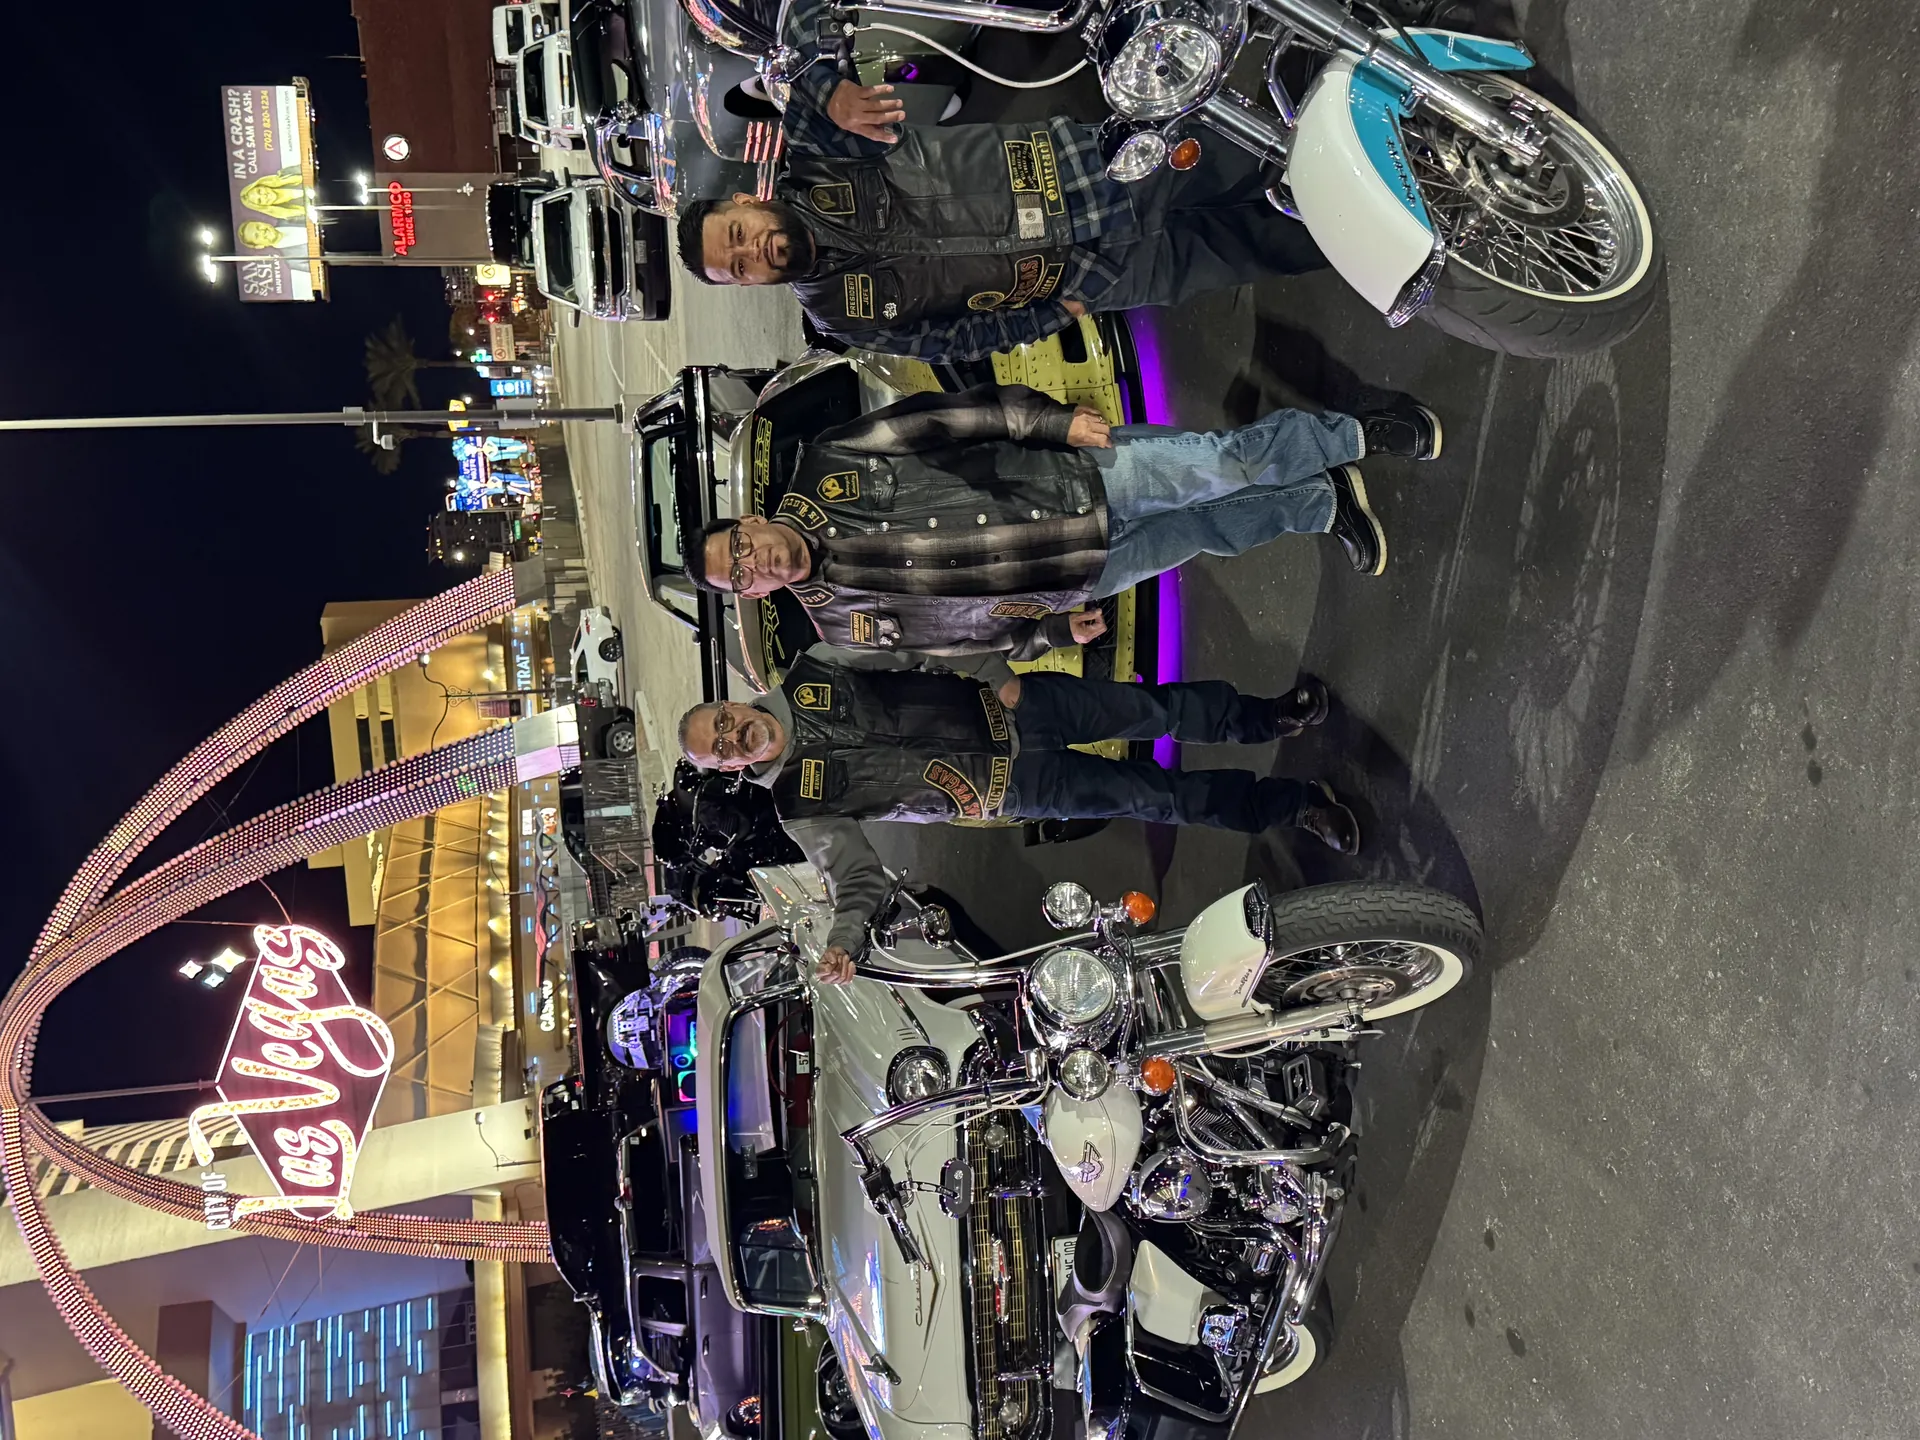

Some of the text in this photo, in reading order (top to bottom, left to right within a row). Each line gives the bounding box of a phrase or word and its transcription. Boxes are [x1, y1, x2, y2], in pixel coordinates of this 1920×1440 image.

[242, 90, 253, 114] ASH.
[227, 89, 247, 179] IN A CRASH?
[245, 126, 256, 148] SAM
[264, 130, 274, 151] (702)
[248, 150, 258, 174] CALL
[1035, 141, 1059, 201] Outreach
[388, 181, 407, 255] ALARMCO
[406, 217, 416, 246] SINCE
[847, 276, 857, 315] PRESIDENT
[981, 690, 1006, 738] OUTREACH
[928, 765, 975, 804] VEGAS
[987, 760, 1006, 808] VICTORY
[188, 923, 395, 1221] Las Vegas
[200, 1171, 231, 1230] CITY OF
